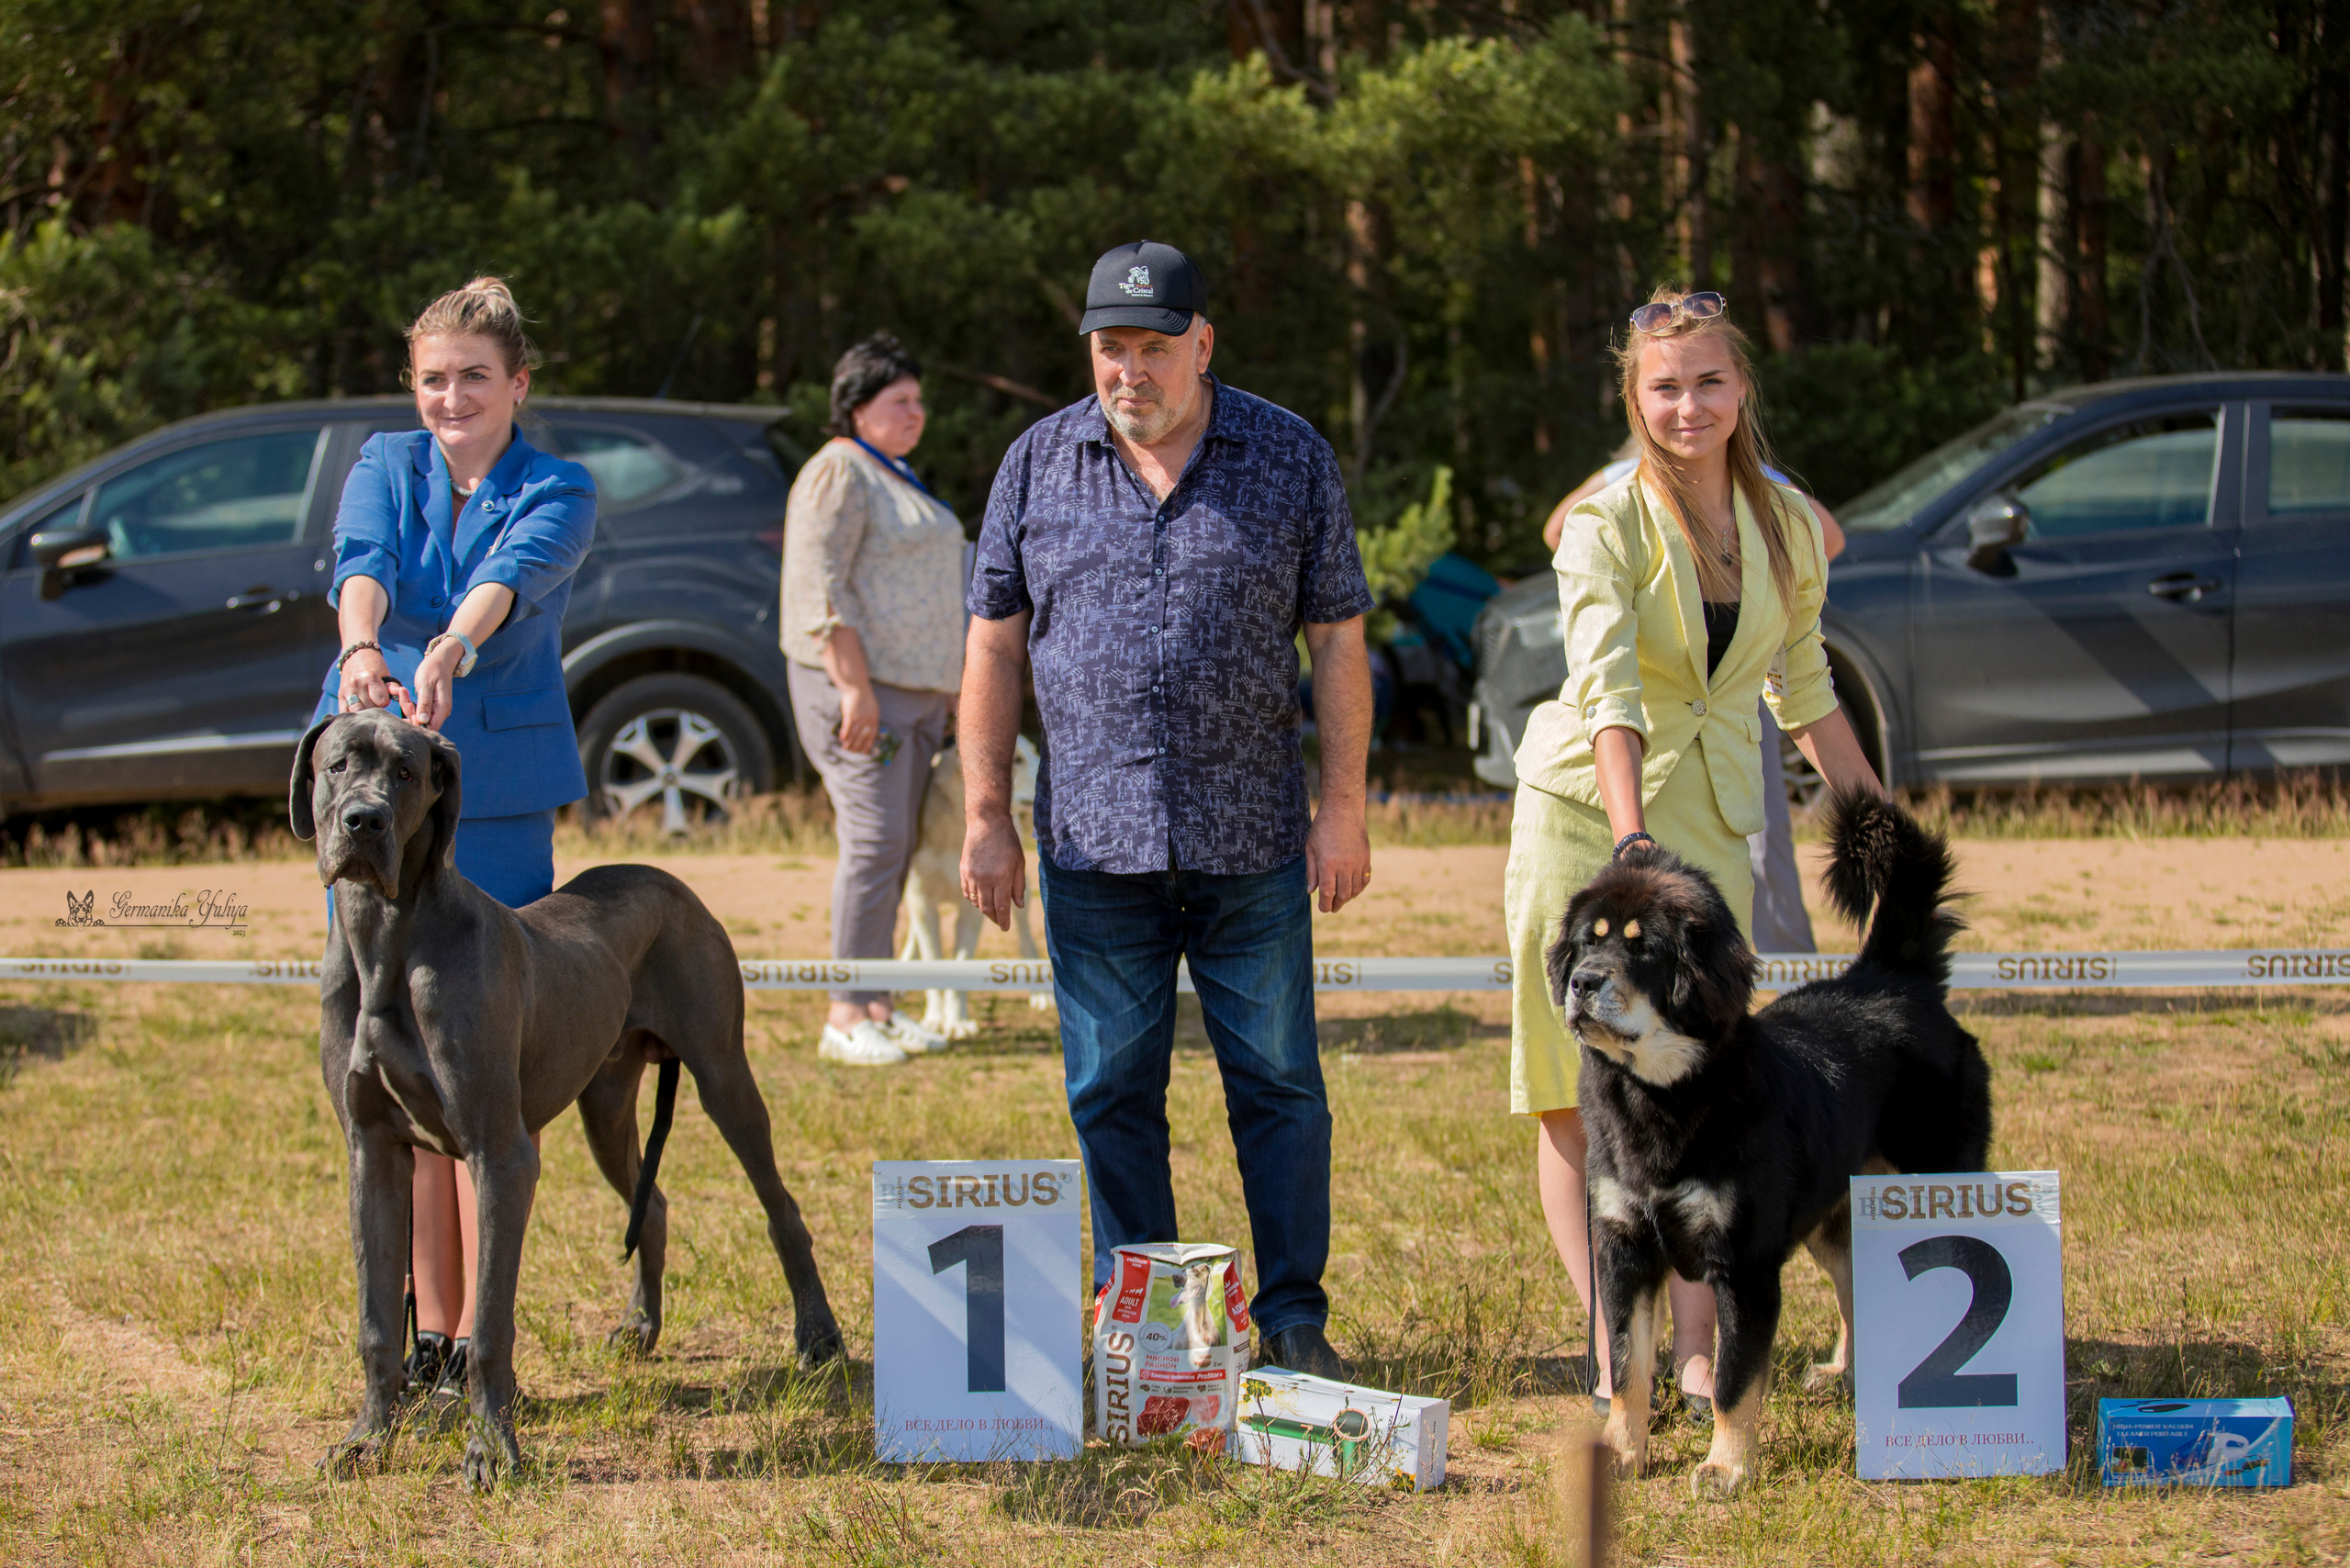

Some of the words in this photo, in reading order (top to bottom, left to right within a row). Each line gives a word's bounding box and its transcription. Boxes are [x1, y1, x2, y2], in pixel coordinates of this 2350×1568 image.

[743, 964, 851, 983] SIRIUS
[990, 964, 1055, 983] IUS
[1997, 956, 2109, 981] SIRIUS
[908, 1171, 1059, 1209] SIRIUS
[1882, 1182, 2032, 1220] SIRIUS
[927, 1224, 1006, 1393] 1
[1119, 1295, 1140, 1307] ADULT
[1897, 1235, 2019, 1409] 2
[1145, 1332, 1167, 1341] 40%
[1144, 1361, 1177, 1370] РАЦИОН
[1146, 1354, 1180, 1363] МЯСНОЙ
[1106, 1332, 1135, 1443] SIRIUS
[905, 1419, 932, 1431] ВСЕ
[934, 1418, 975, 1433] ДЕЛО
[979, 1419, 988, 1430] В
[1886, 1435, 1912, 1447] ВСЕ
[1915, 1434, 1955, 1448] ДЕЛО
[1959, 1434, 1968, 1445] В
